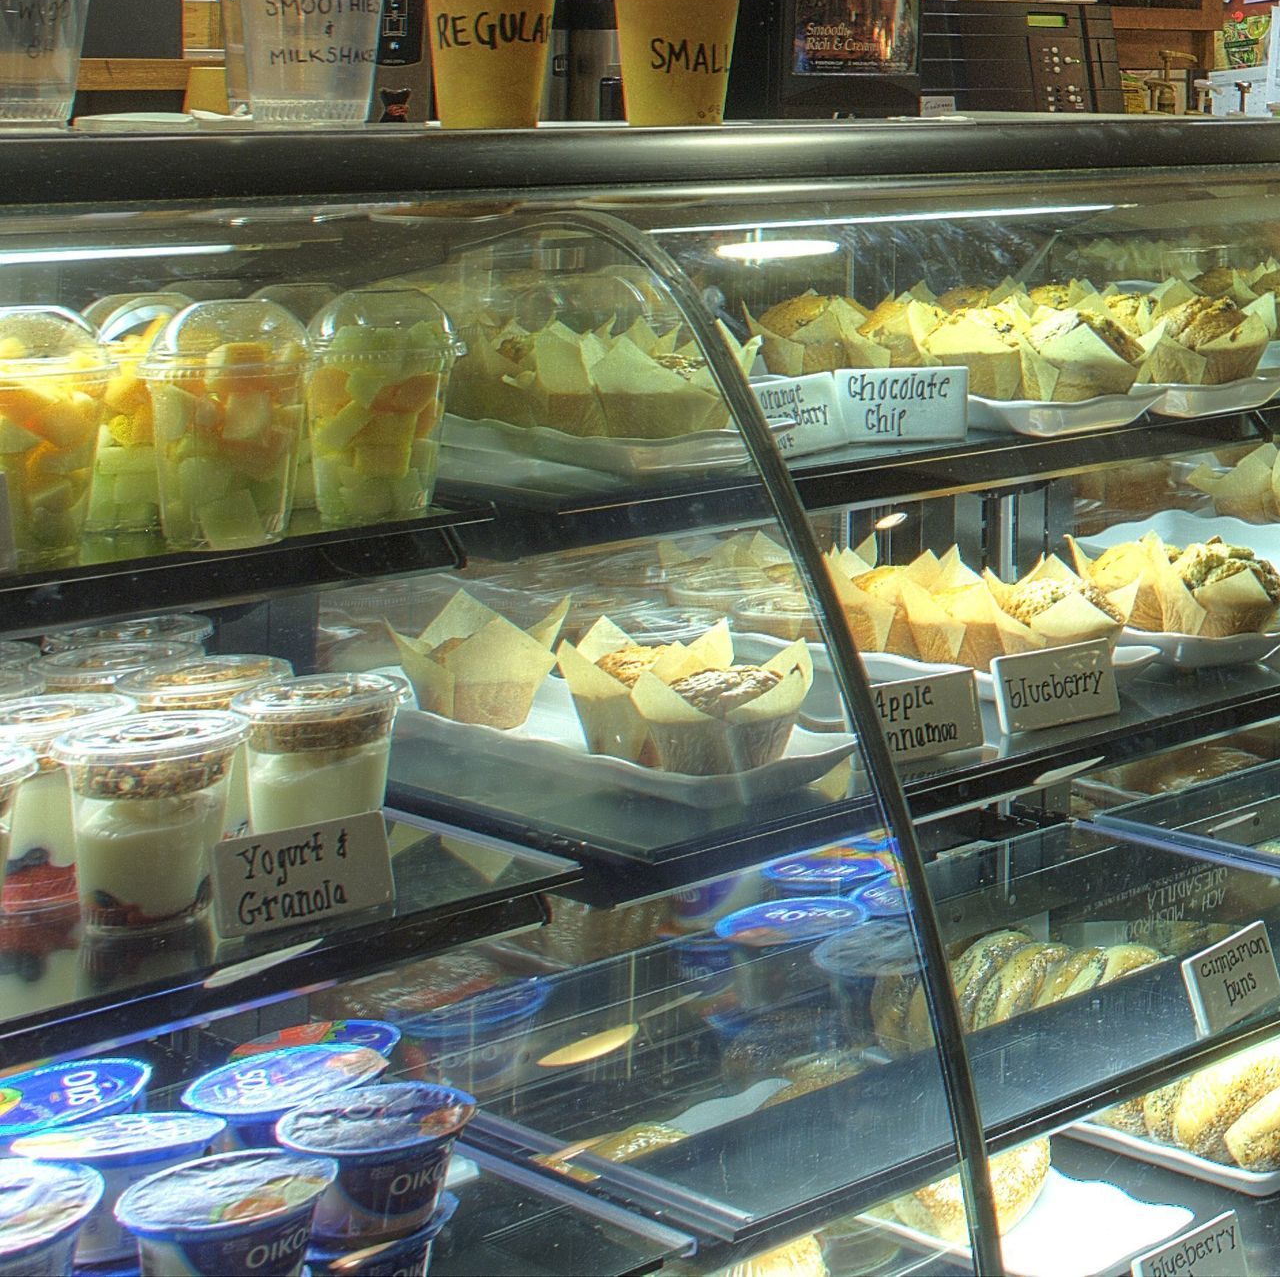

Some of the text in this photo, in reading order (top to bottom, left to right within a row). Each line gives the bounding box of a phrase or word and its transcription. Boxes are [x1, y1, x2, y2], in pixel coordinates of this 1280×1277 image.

[760, 384, 804, 413] orange
[848, 373, 951, 402] Chocolate
[865, 403, 907, 436] Chip
[1005, 670, 1104, 710] blueberry
[886, 721, 958, 752] nnamon
[236, 831, 324, 887] Yogurt
[238, 879, 348, 926] Granola
[1200, 936, 1270, 978] cinnamon
[1223, 971, 1257, 1007] buns
[1149, 1225, 1238, 1277] blueberry
